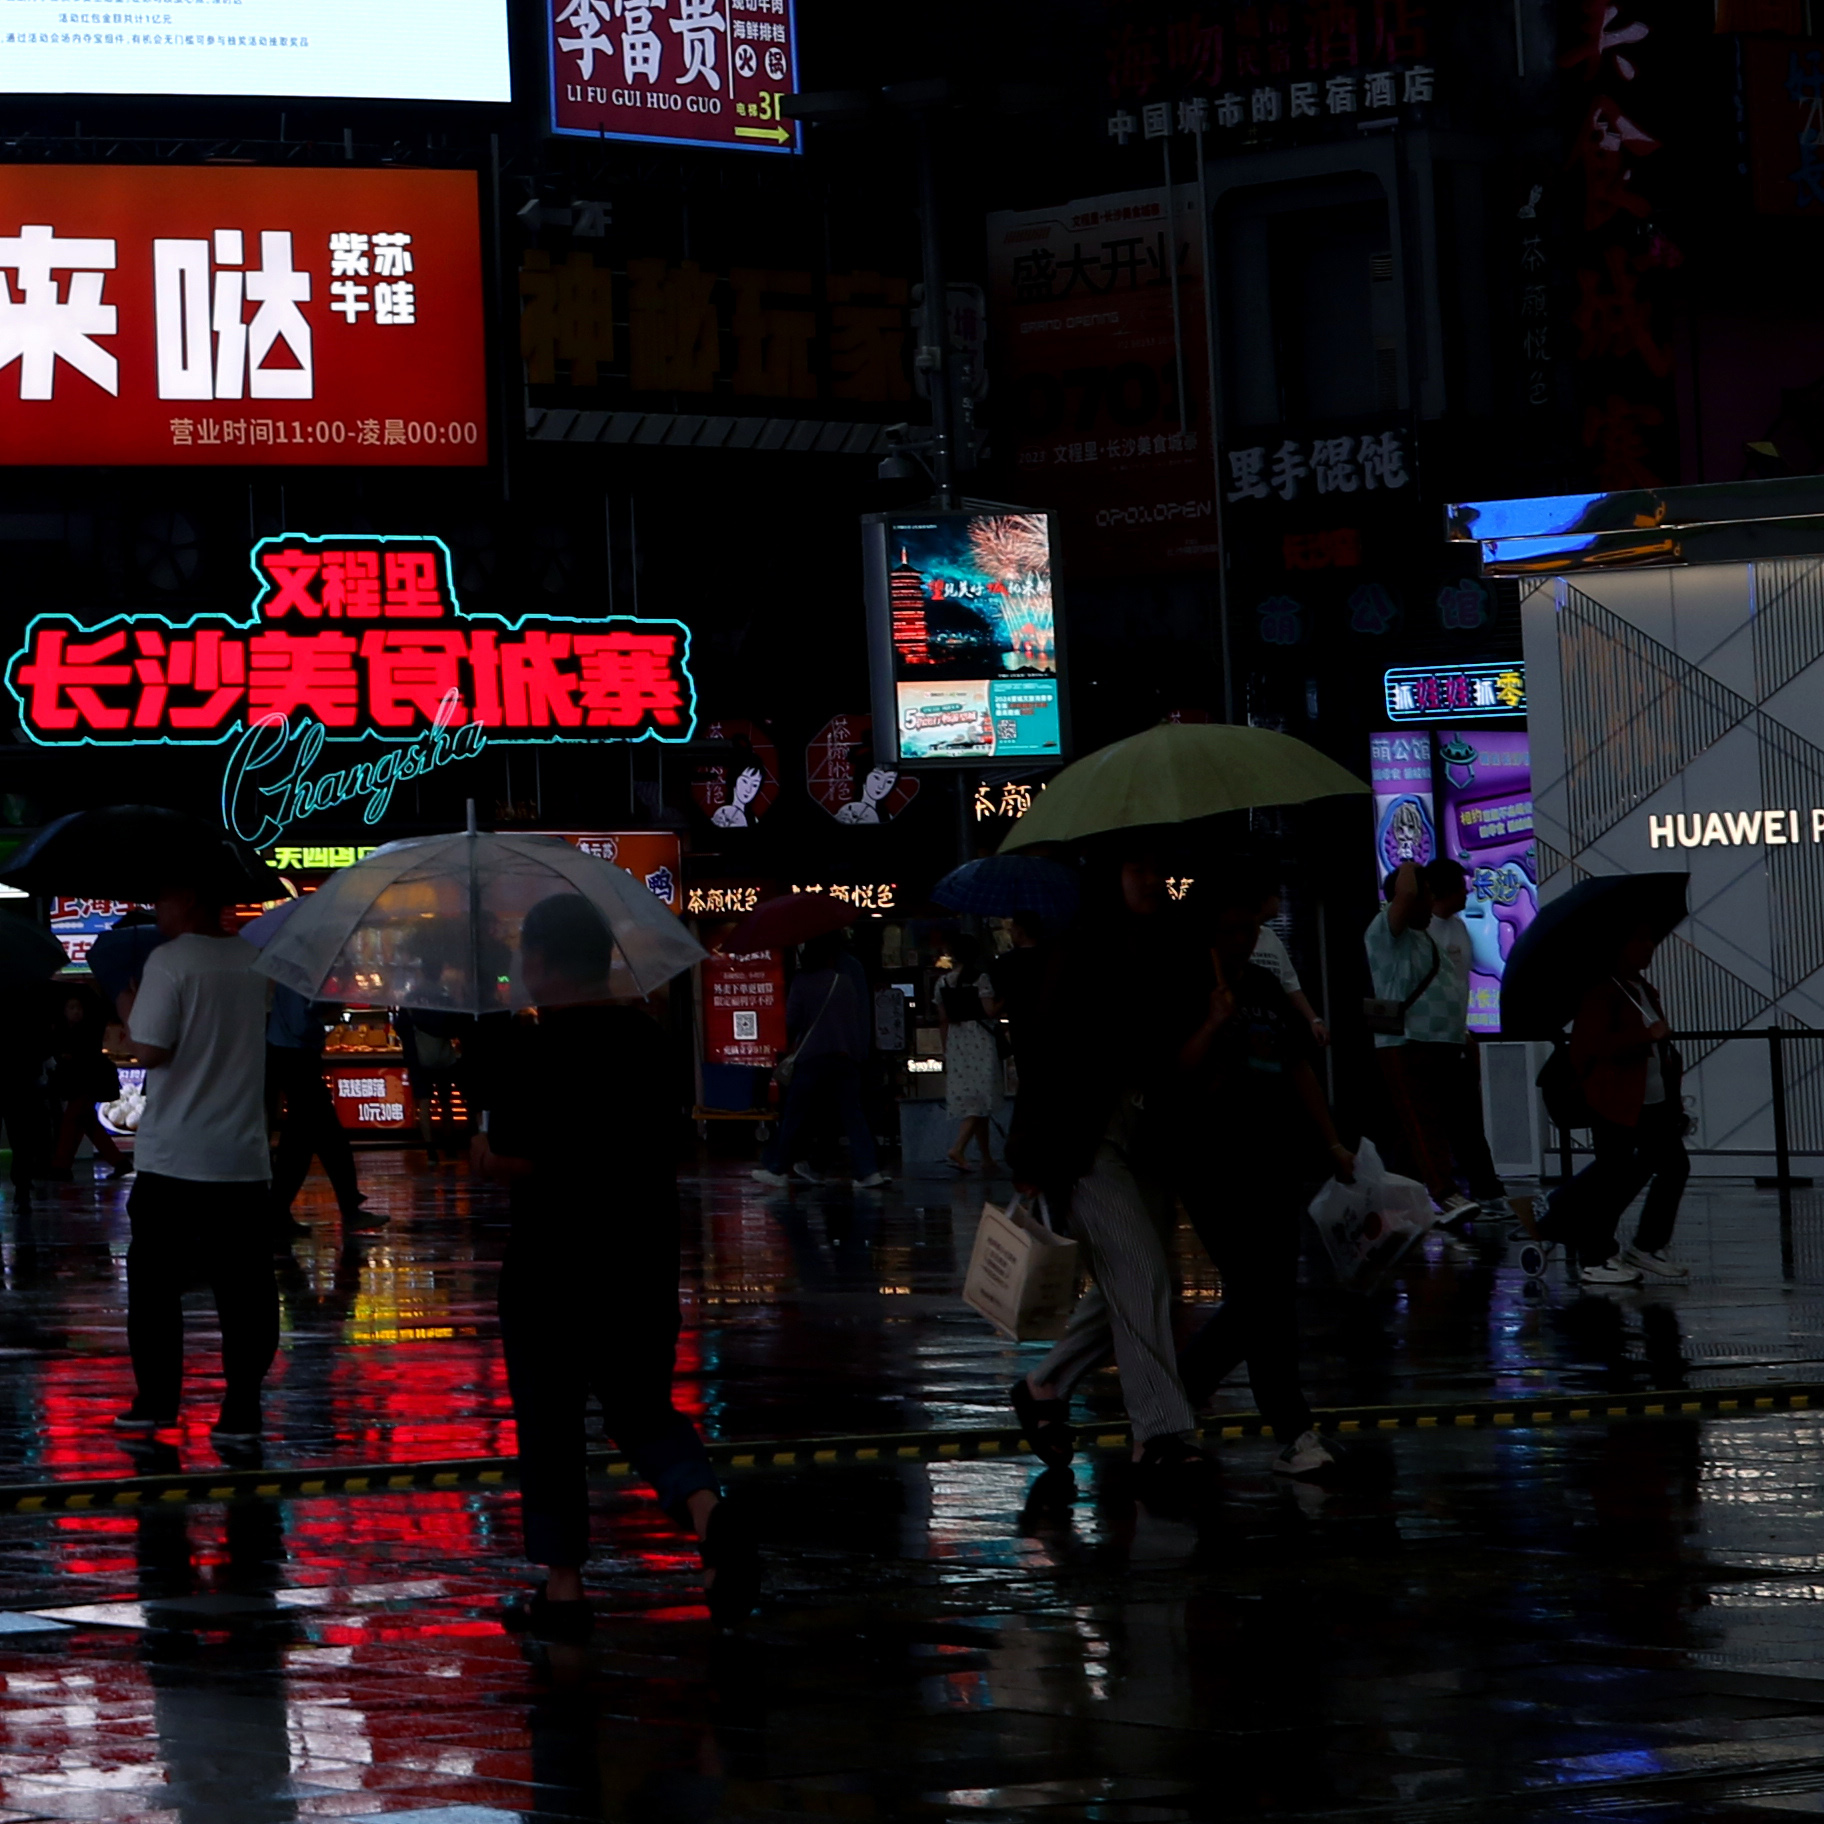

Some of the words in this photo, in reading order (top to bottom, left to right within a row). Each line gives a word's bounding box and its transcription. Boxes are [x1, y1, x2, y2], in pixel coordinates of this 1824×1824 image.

[732, 19, 786, 44] 海鲜排档
[567, 84, 583, 102] LI
[586, 86, 609, 105] FU
[611, 88, 642, 108] GUI
[646, 91, 684, 112] HUO
[687, 94, 722, 116] GUO
[1108, 65, 1436, 146] 中国城市的民宿酒店
[328, 231, 414, 279] 紫苏
[330, 280, 417, 327] 牛蛙
[169, 417, 479, 449] 营业时间11:00-凌晨00:00
[16, 629, 684, 730] 长沙美食城寨
[1371, 736, 1431, 763] 萌公馆
[1649, 810, 1800, 850] HUAWEI
[1472, 867, 1520, 902] 长沙
